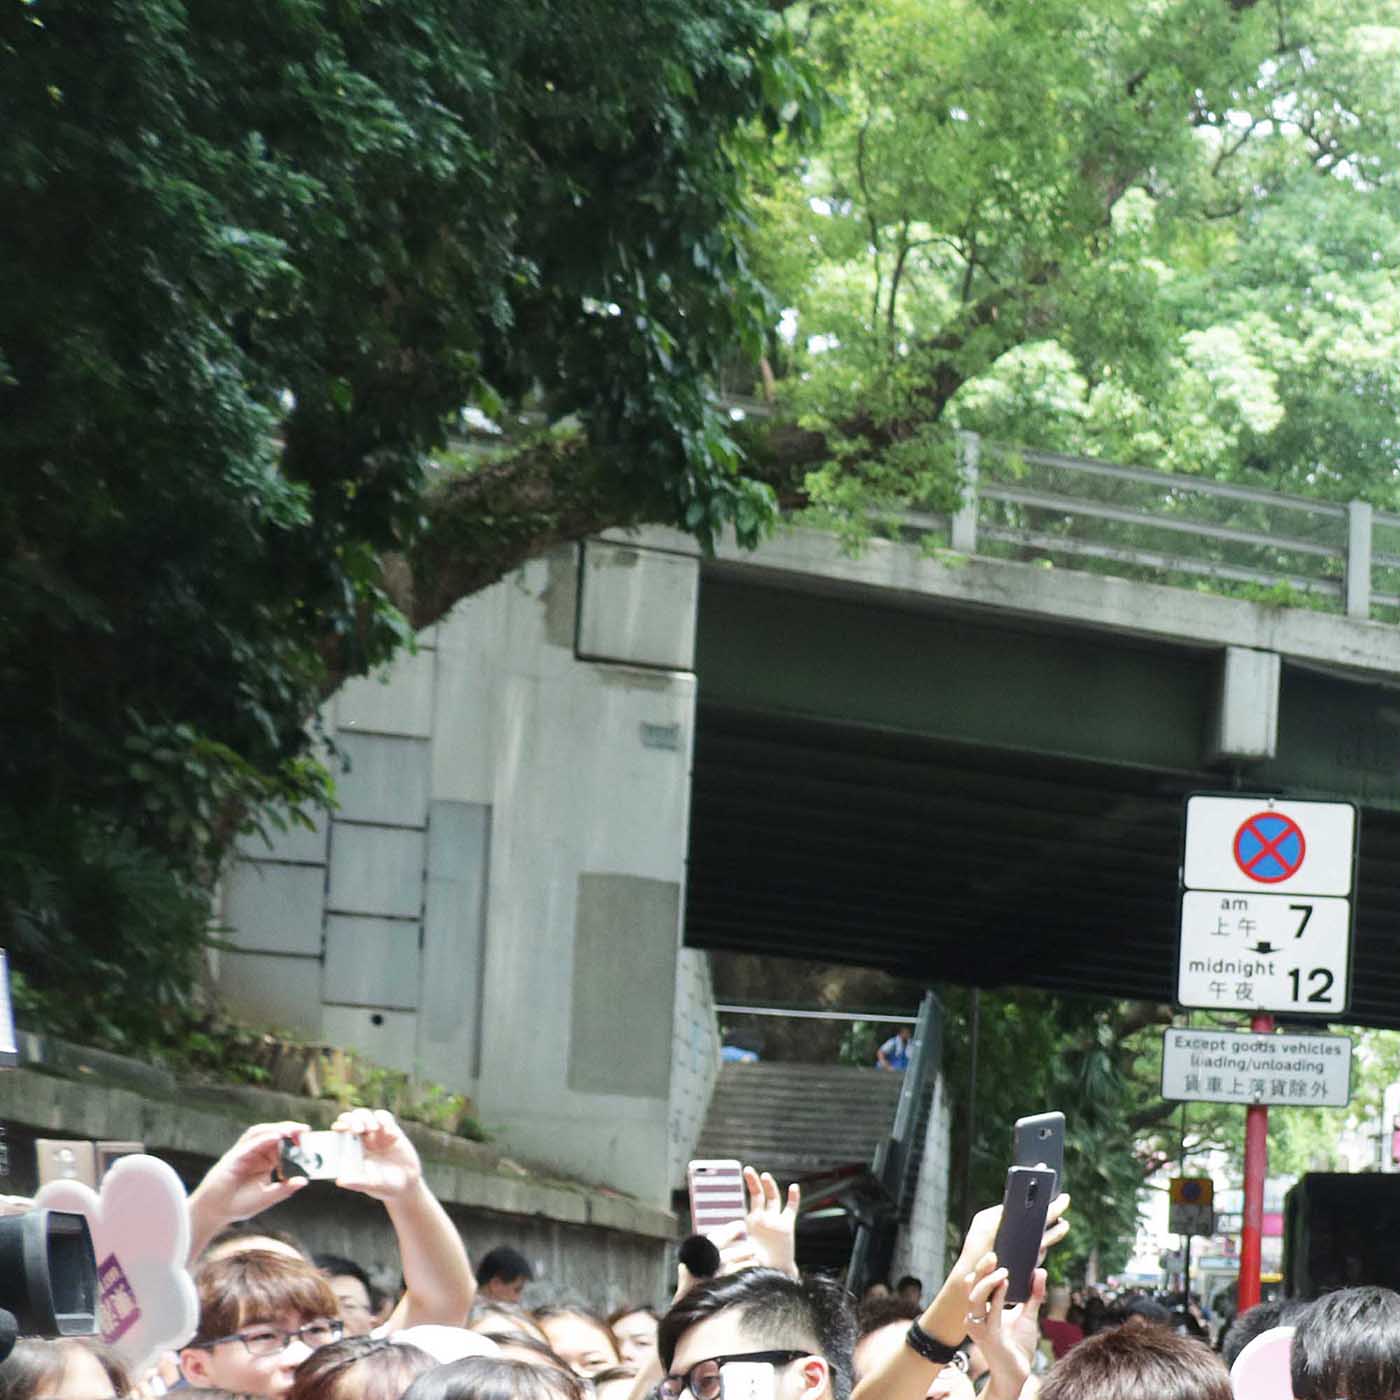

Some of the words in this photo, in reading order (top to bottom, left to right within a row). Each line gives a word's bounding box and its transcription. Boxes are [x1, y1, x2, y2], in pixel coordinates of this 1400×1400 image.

[1220, 898, 1249, 911] am
[1210, 915, 1258, 937] 上午
[1289, 904, 1313, 938] 7
[1188, 957, 1275, 977] midnight
[1208, 979, 1255, 1002] 午夜
[1287, 967, 1335, 1003] 12
[1174, 1035, 1226, 1052] Except
[1231, 1039, 1276, 1054] goods
[1283, 1041, 1342, 1056] vehicles
[1190, 1054, 1325, 1075] loading/unloading
[1183, 1075, 1329, 1099] 貨車上落貨除外
